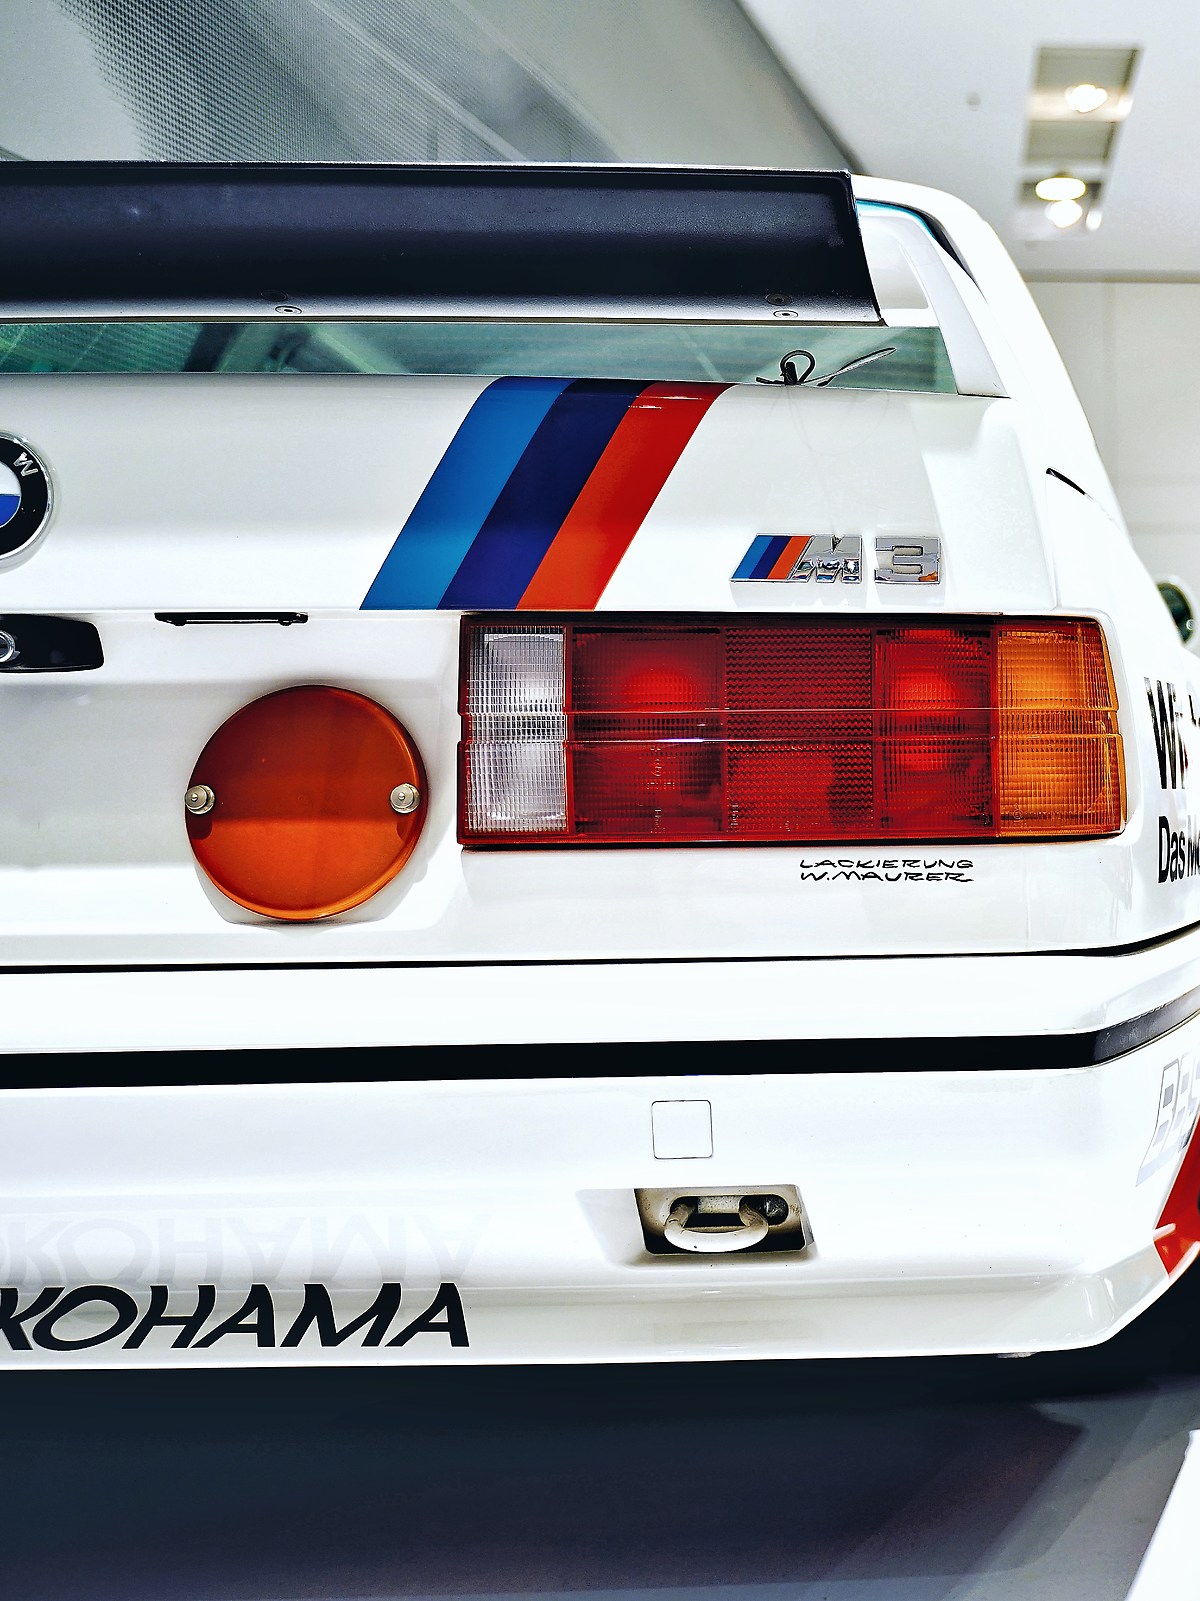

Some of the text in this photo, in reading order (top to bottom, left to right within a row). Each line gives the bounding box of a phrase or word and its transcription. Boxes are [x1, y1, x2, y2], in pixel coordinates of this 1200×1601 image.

[786, 533, 941, 584] M3
[799, 859, 974, 869] LACKIERUNG
[1158, 815, 1185, 883] Das
